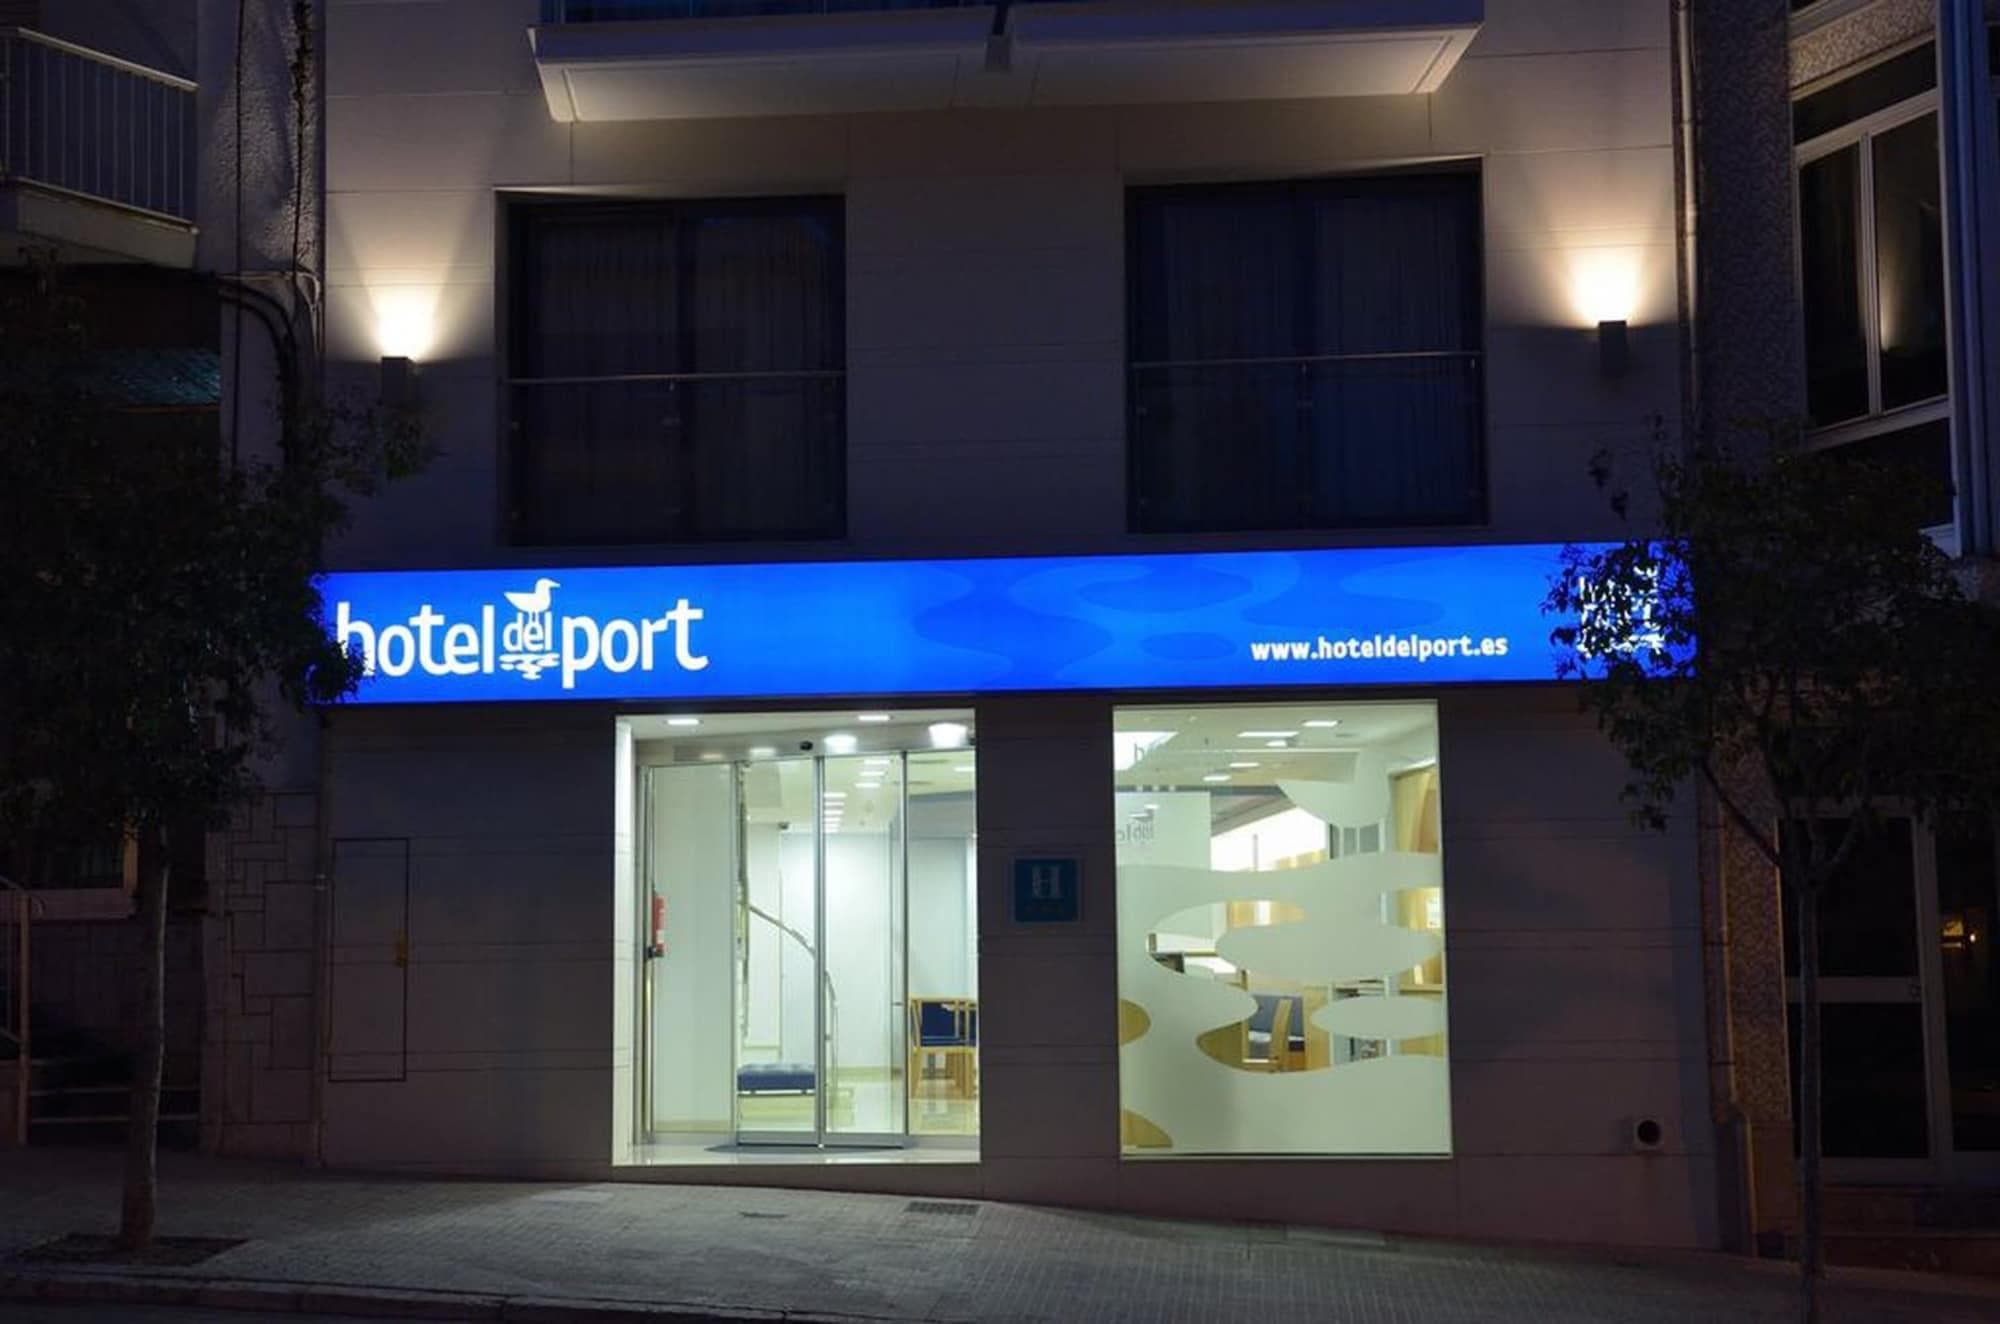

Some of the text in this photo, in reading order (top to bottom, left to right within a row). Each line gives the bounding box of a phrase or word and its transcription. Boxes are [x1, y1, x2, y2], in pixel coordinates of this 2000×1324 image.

[337, 599, 709, 689] hotel del port
[1251, 634, 1508, 662] www.hoteldelport.es
[1032, 865, 1061, 898] H
